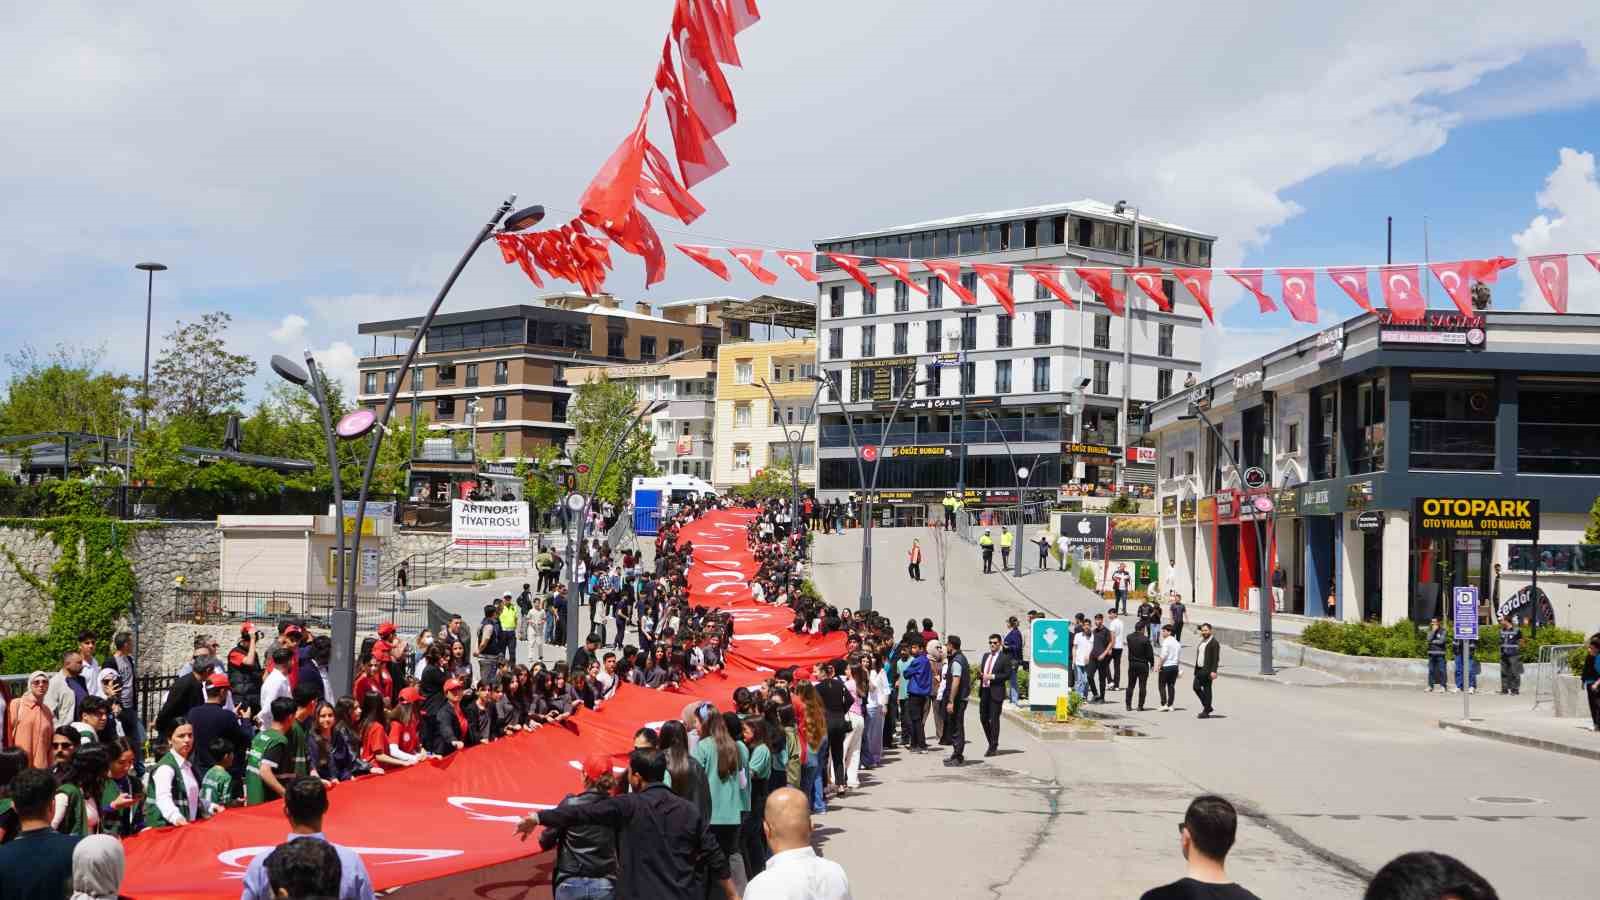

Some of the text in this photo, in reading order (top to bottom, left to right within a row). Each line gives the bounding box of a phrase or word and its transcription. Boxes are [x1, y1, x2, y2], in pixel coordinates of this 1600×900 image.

[1423, 498, 1532, 517] OTOPARK
[459, 514, 521, 527] TİYATROSU
[1423, 518, 1532, 529] OTO YIKAMA OTO KUAFÖR
